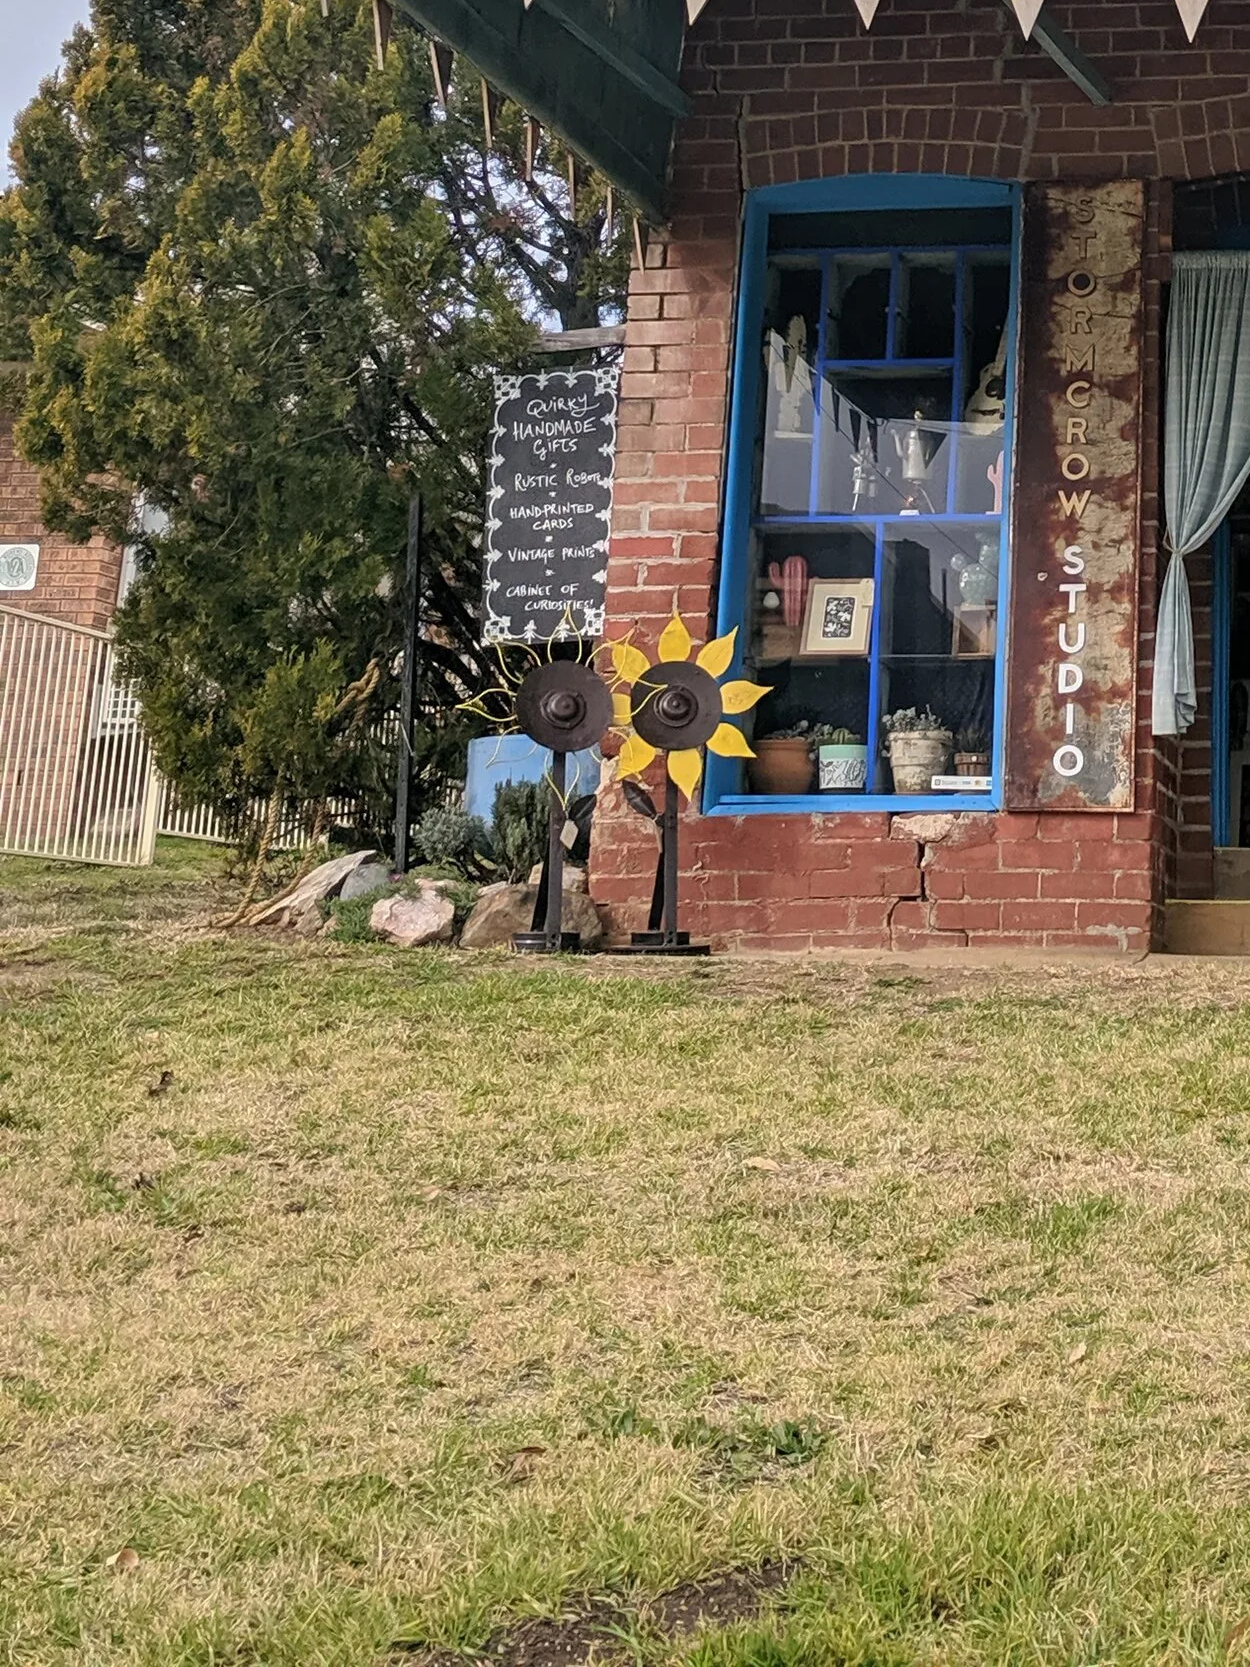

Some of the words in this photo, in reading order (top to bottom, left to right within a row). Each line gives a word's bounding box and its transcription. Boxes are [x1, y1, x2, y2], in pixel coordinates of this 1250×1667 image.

[1058, 195, 1097, 519] STORMCROW
[513, 417, 597, 441] HANDMADE
[515, 473, 558, 491] RUSTIC
[510, 502, 595, 519] HAND-PRINTED
[532, 517, 574, 531] CARDS
[508, 547, 555, 564] VINTAGE
[562, 545, 595, 560] PRINTS
[506, 584, 553, 597] CABINET
[560, 583, 579, 596] OF
[1053, 544, 1087, 777] STUDIO
